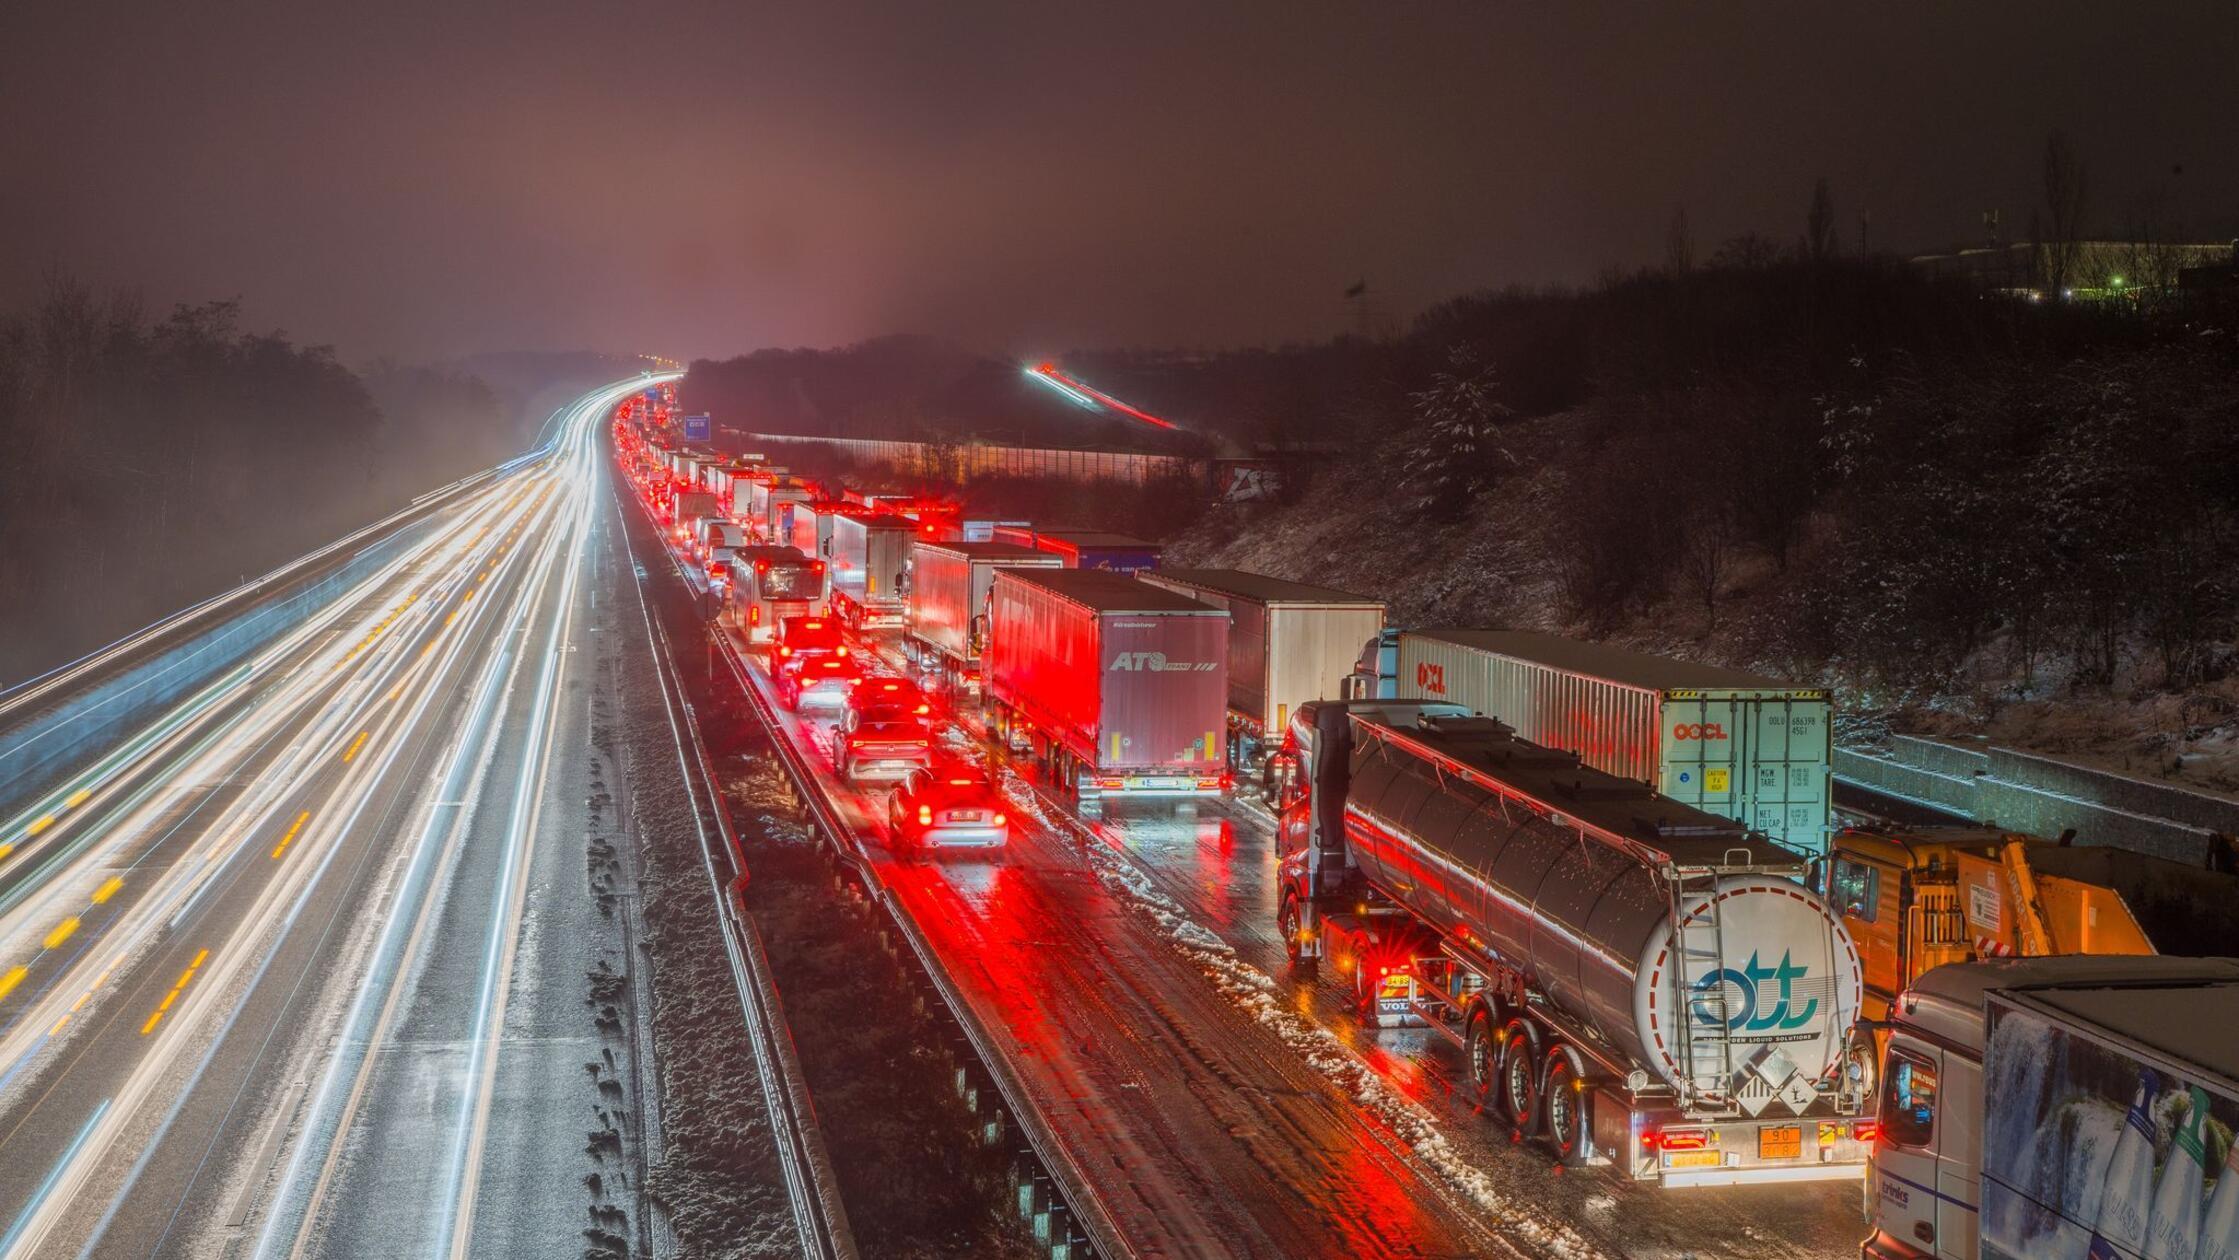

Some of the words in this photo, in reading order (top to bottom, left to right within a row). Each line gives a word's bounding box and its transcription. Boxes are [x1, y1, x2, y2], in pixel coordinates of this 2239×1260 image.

[1791, 717, 1814, 726] 686398
[1673, 723, 1728, 740] OOCL
[1773, 1130, 1789, 1141] 90
